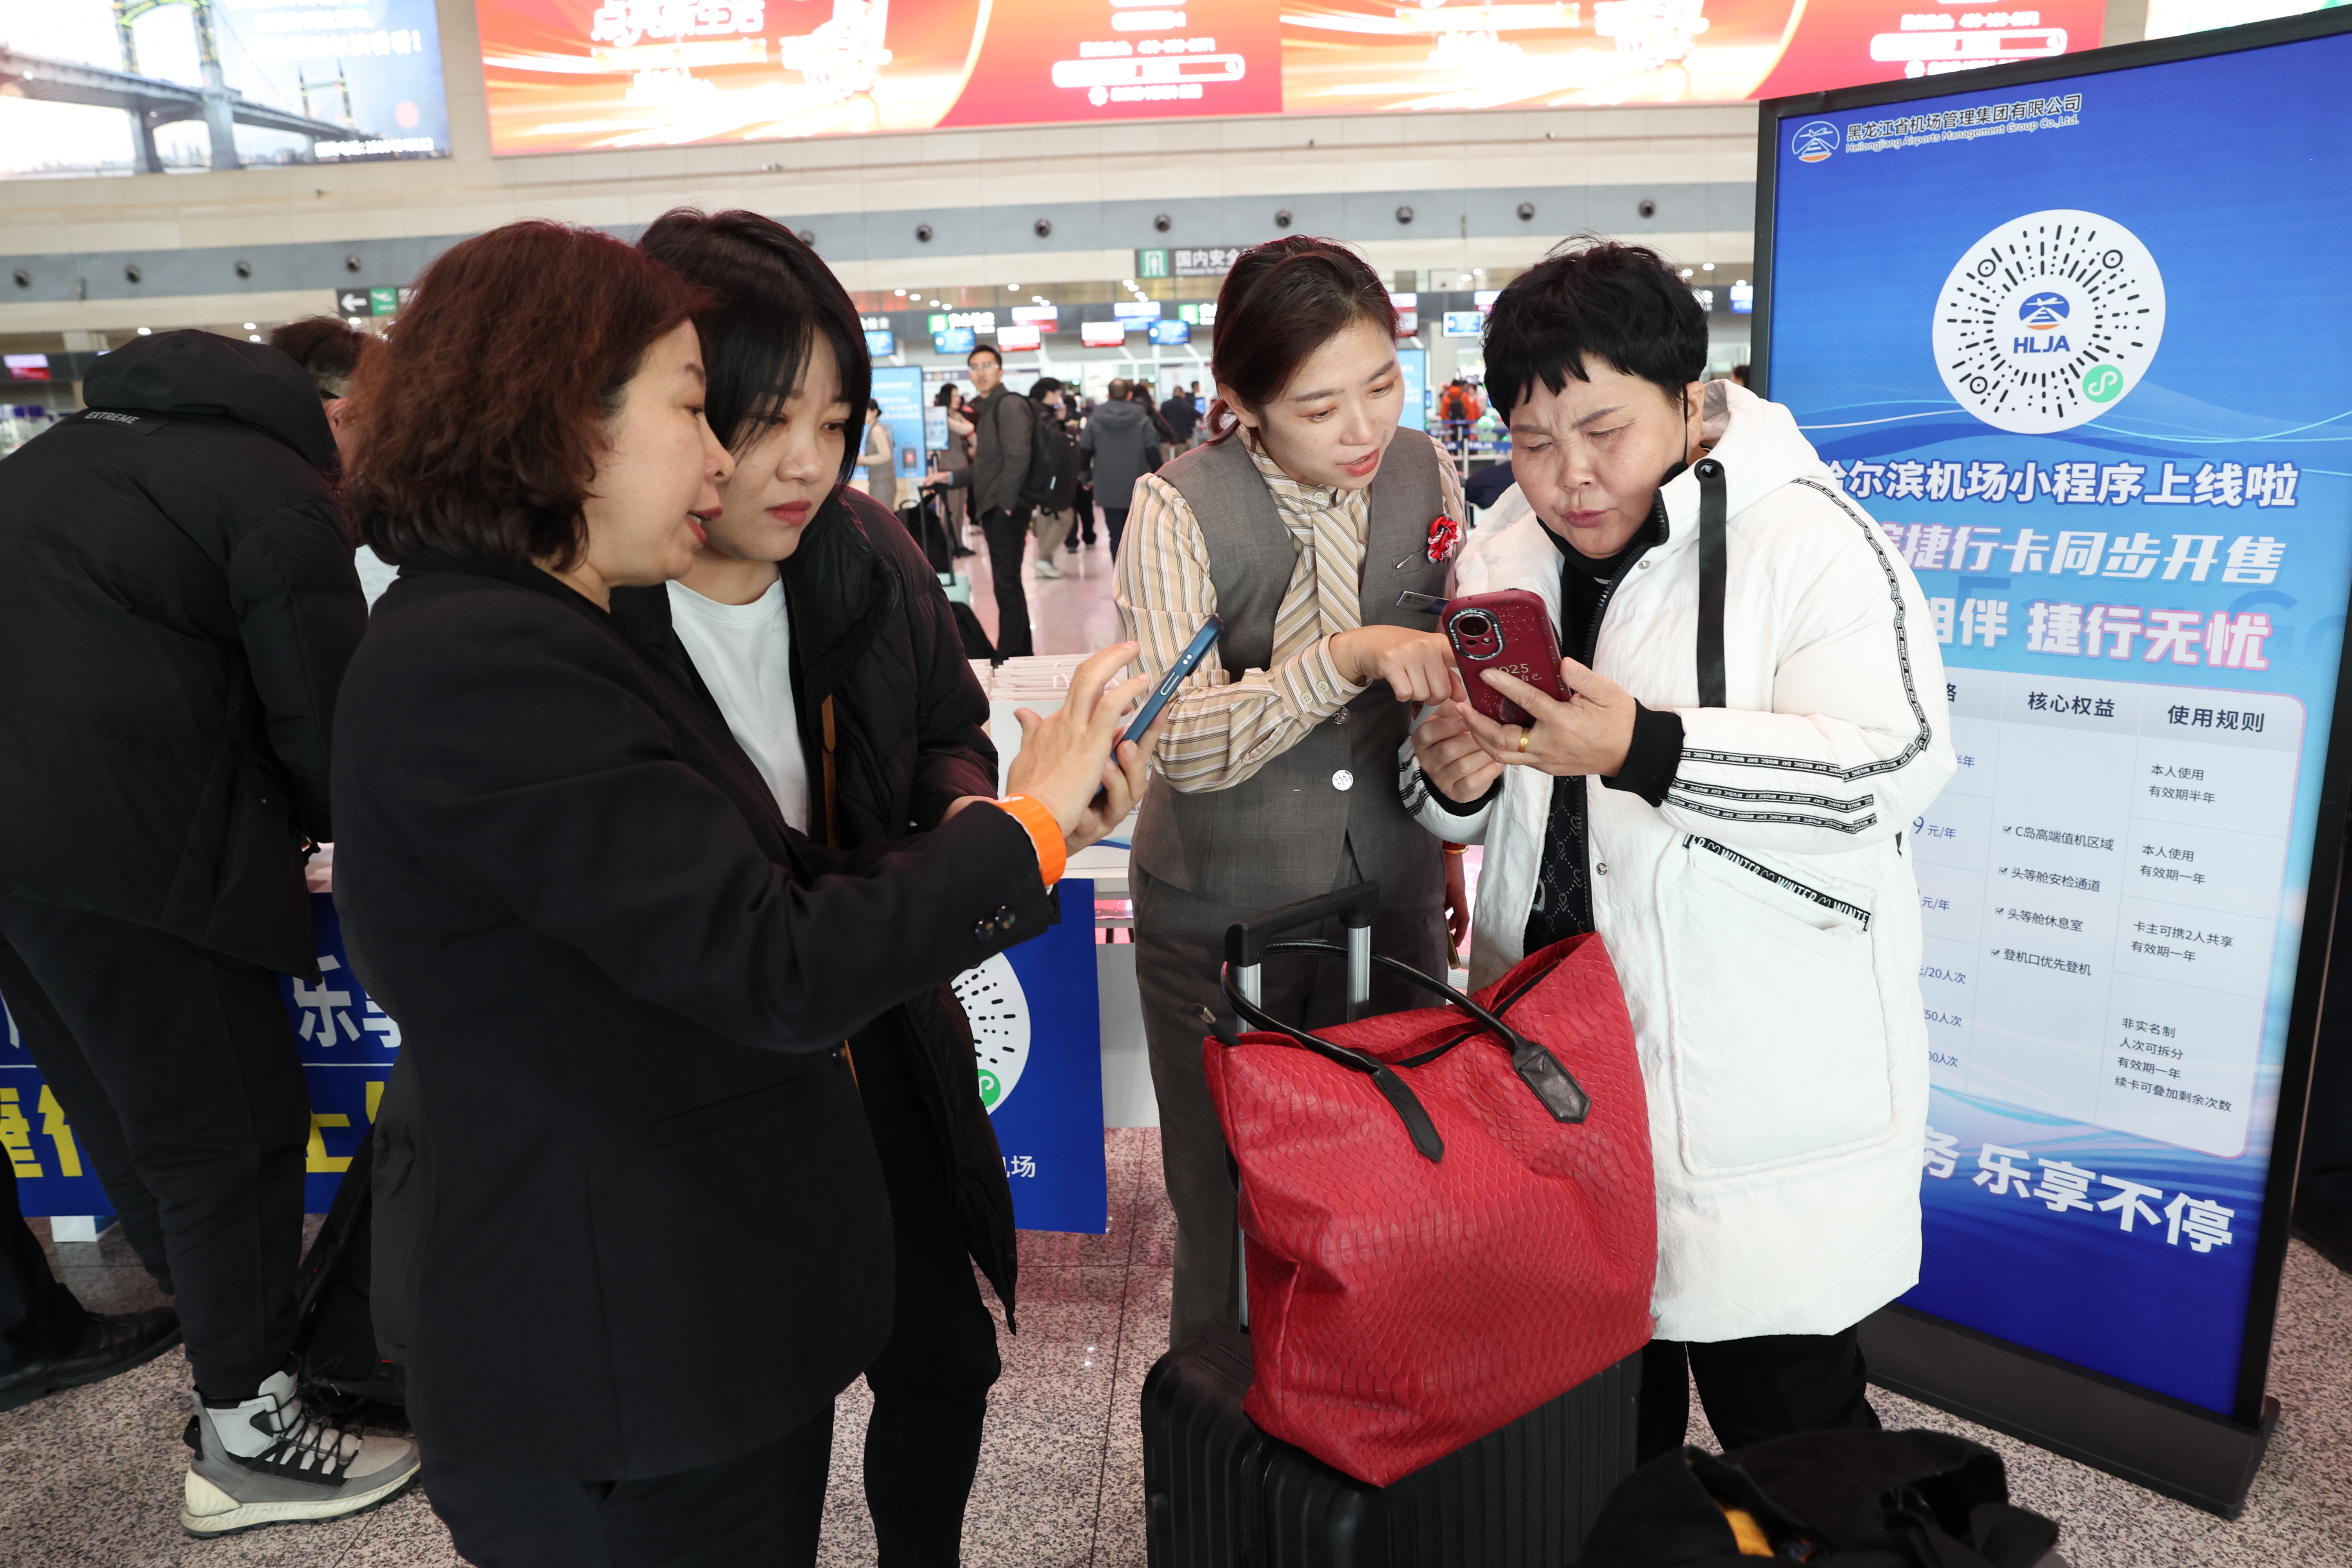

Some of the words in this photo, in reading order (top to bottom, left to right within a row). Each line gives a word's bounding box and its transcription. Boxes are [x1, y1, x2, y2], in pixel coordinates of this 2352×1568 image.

[1847, 93, 2082, 141] 黑龙江省机场管理集团有限公司
[1846, 139, 1901, 153] Heilongjiang
[1903, 134, 1940, 147] Airports
[1942, 125, 2005, 142] Management
[2007, 120, 2038, 134] Group
[2040, 114, 2080, 129] Co.,Ltd.
[2013, 335, 2071, 354] HLJA
[85, 412, 140, 424] EXTREME
[2027, 603, 2269, 669] 捷行无忧
[1491, 663, 1529, 673] 025
[2028, 691, 2115, 718] 核心权益
[2167, 705, 2265, 733] 使用规则
[2151, 764, 2204, 781] 本人使用
[2149, 785, 2216, 804] 有效期半年
[1927, 825, 1956, 839] 元/年
[2015, 825, 2114, 851] C岛高端值机区域
[2141, 844, 2194, 862] 本人使用
[2011, 867, 2101, 892] 头等舱安检通道
[2140, 865, 2206, 885] 有效期一年
[1922, 897, 1950, 911] 元/年
[2007, 908, 2083, 932] 头等舱休息室
[2134, 921, 2234, 948] 卡主可携2人共享
[2003, 948, 2092, 976] 登机口优先登机
[2131, 941, 2196, 962] 有效期一年
[2122, 1017, 2176, 1038] 非实名制
[2120, 1038, 2183, 1060] 人次可拆分
[2117, 1056, 2181, 1079] 有效期一年
[2115, 1076, 2232, 1112] 续卡可叠加剩余次数
[1007, 1155, 1036, 1178] 场
[1973, 1142, 2235, 1253] 乐享不停
